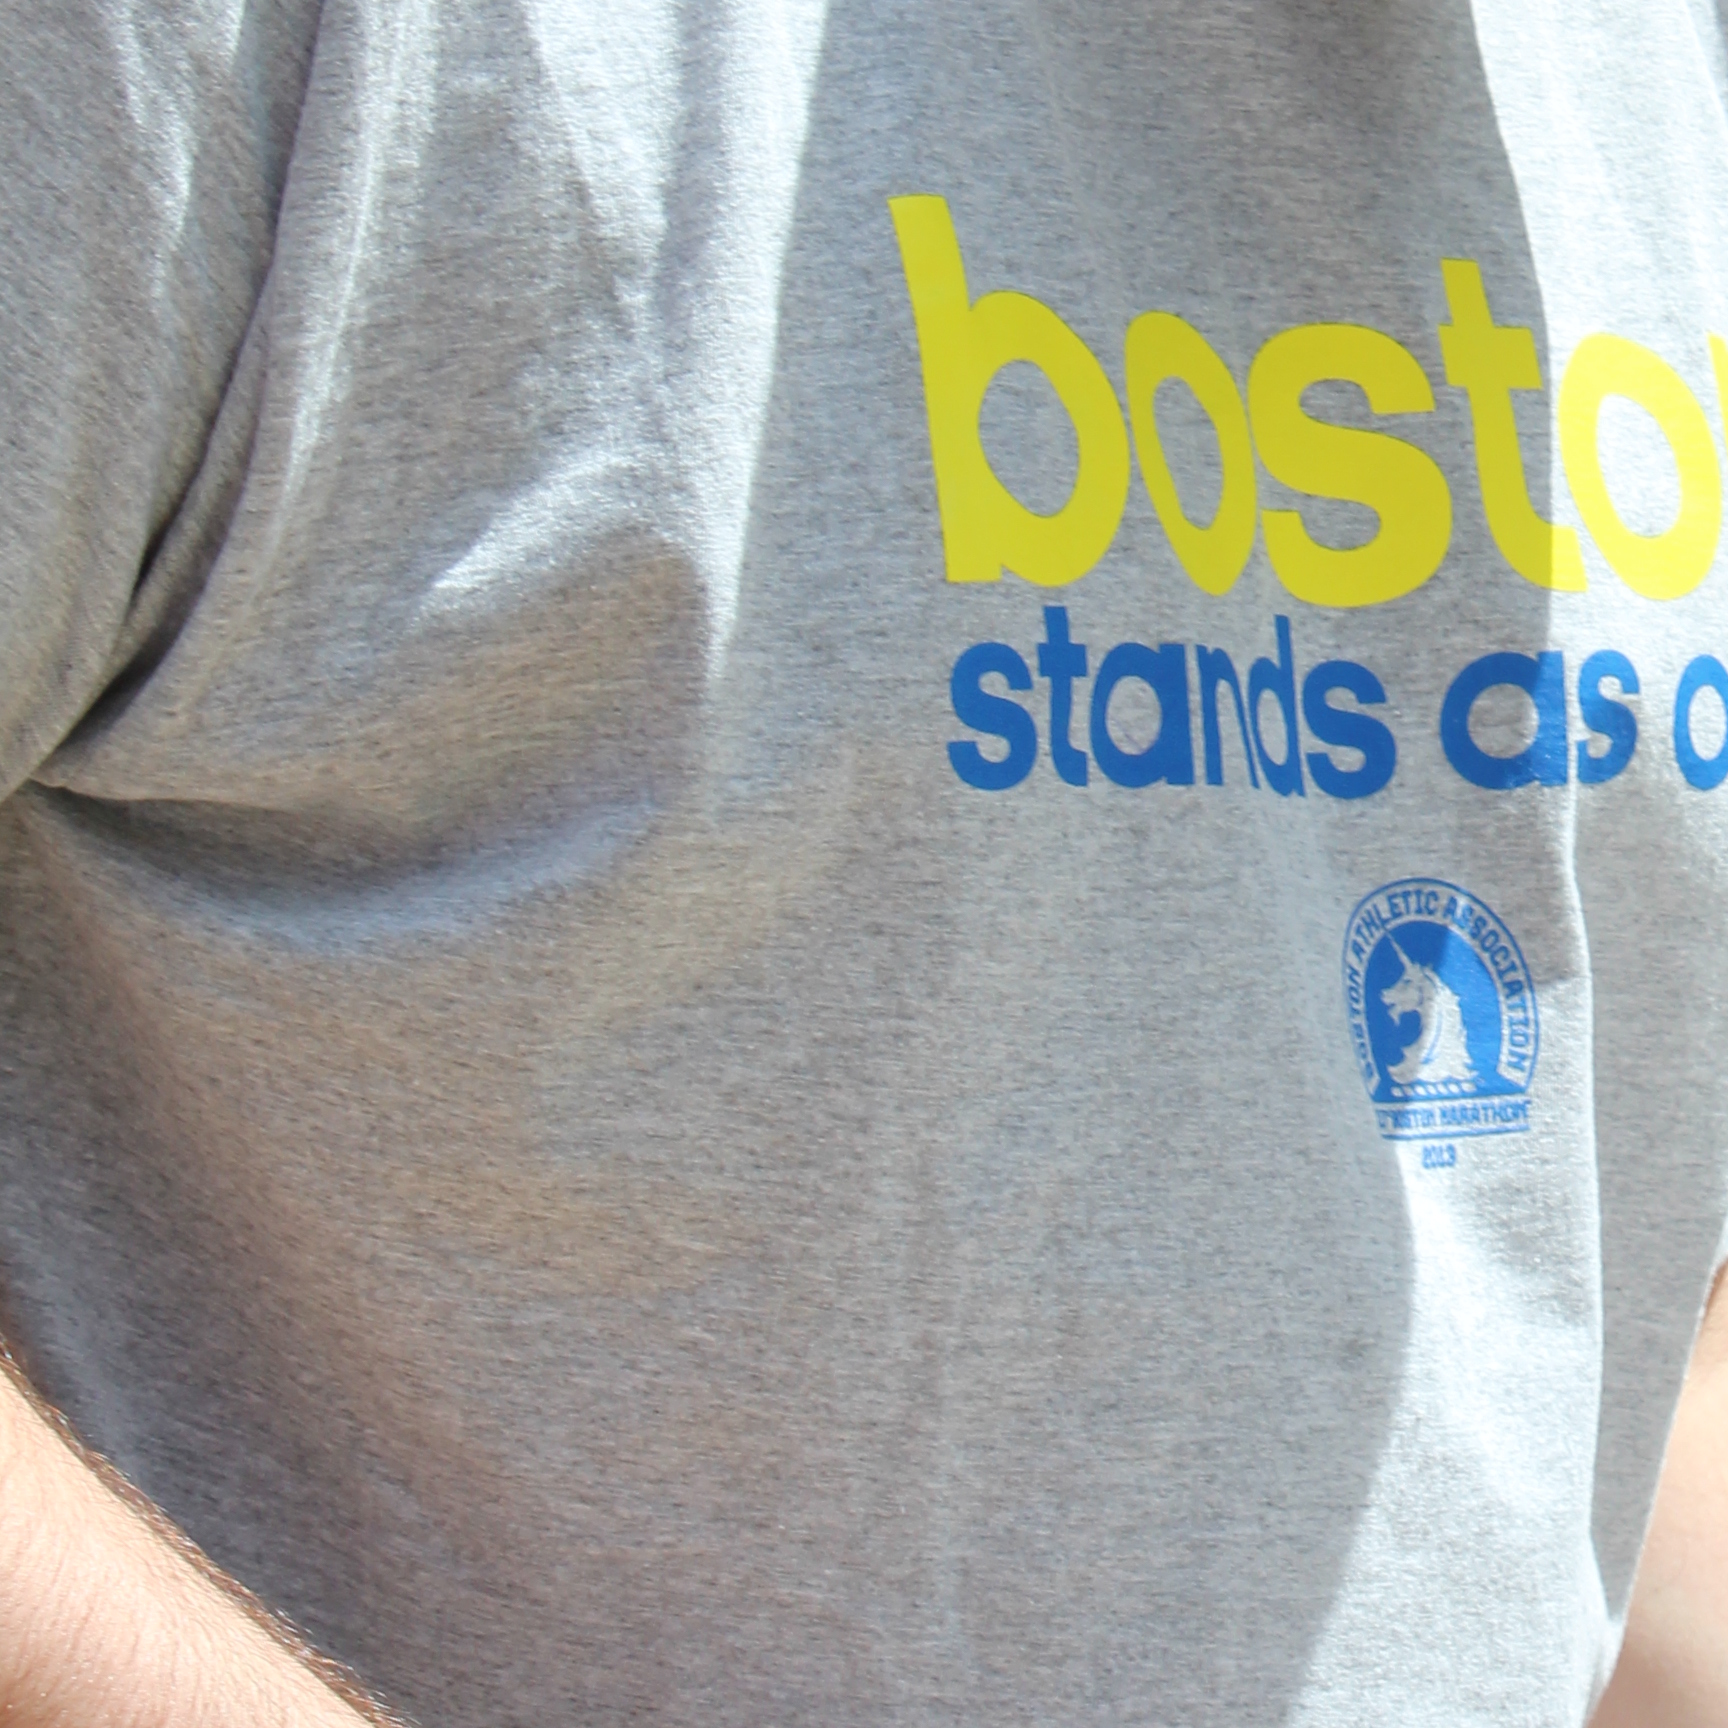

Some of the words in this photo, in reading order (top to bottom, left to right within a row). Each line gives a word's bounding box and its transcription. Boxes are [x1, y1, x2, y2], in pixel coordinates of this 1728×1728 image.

[947, 605, 1398, 801] stands
[1439, 649, 1640, 790] as
[1351, 889, 1440, 961] ATHLETIC
[1442, 896, 1531, 1073] ASSOCIATION
